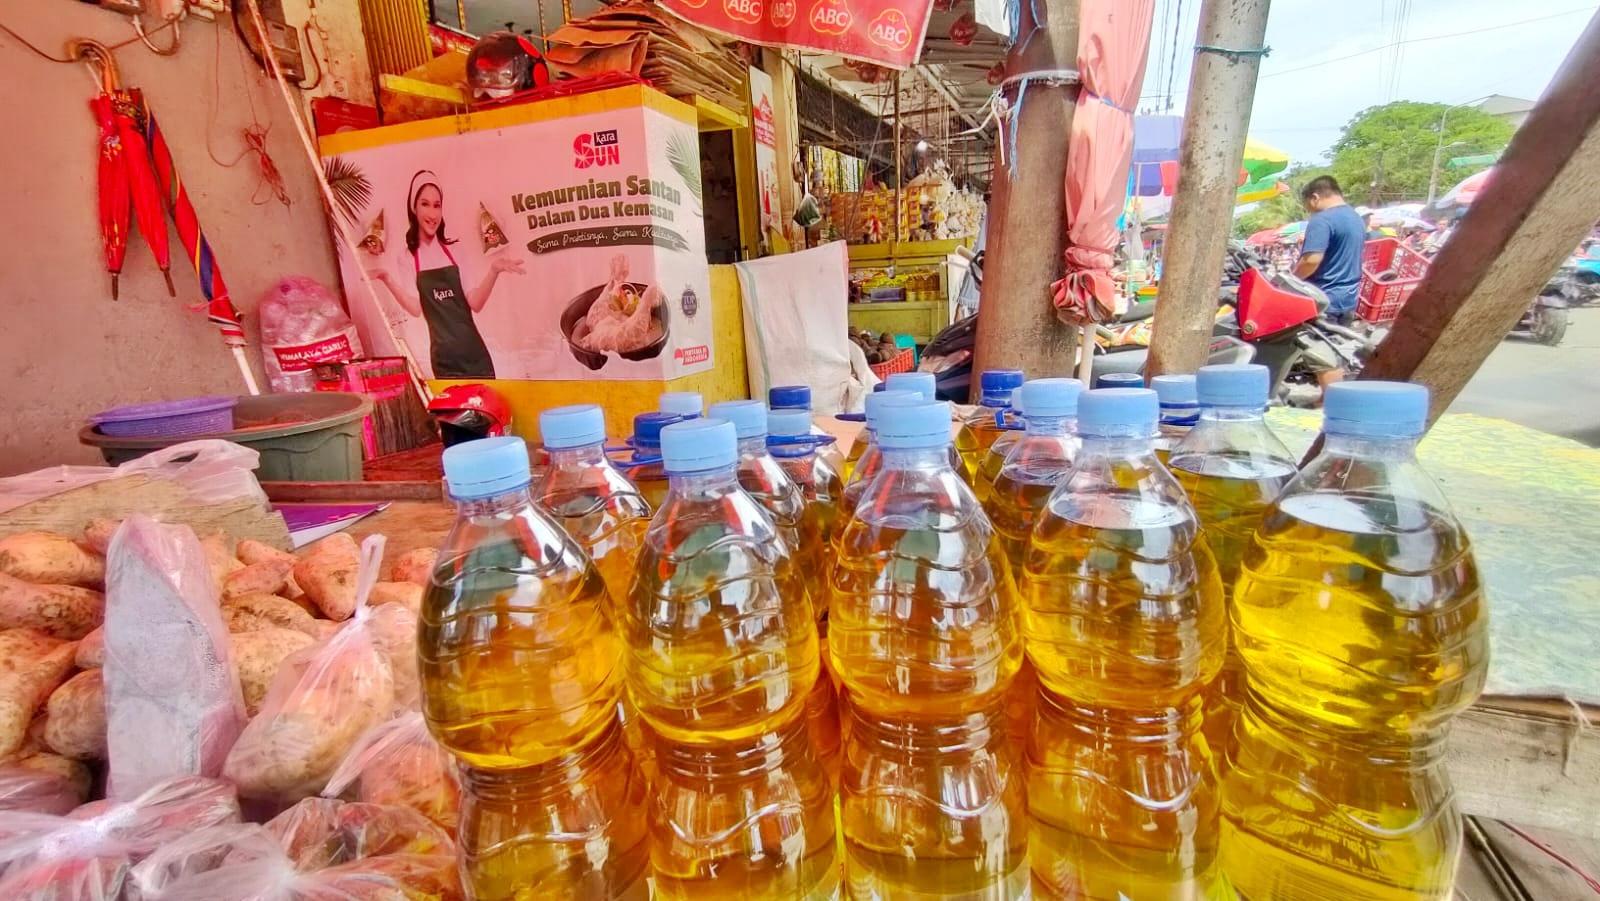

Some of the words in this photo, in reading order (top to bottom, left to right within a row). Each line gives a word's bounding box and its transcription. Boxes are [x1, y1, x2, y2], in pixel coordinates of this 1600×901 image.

[728, 1, 760, 17] ABC
[775, 3, 792, 19] ABC
[816, 10, 849, 28] ABC
[872, 24, 907, 44] ABC
[597, 132, 616, 145] kara
[573, 133, 620, 169] SUN
[511, 178, 621, 213] Kemurnian
[626, 175, 681, 206] Santan
[527, 210, 576, 230] Dalam
[579, 204, 610, 221] Dua
[613, 201, 674, 222] Kemasan
[536, 240, 559, 253] Sama
[612, 228, 637, 241] Sama
[433, 289, 454, 301] kara
[321, 340, 347, 354] GARLIC
